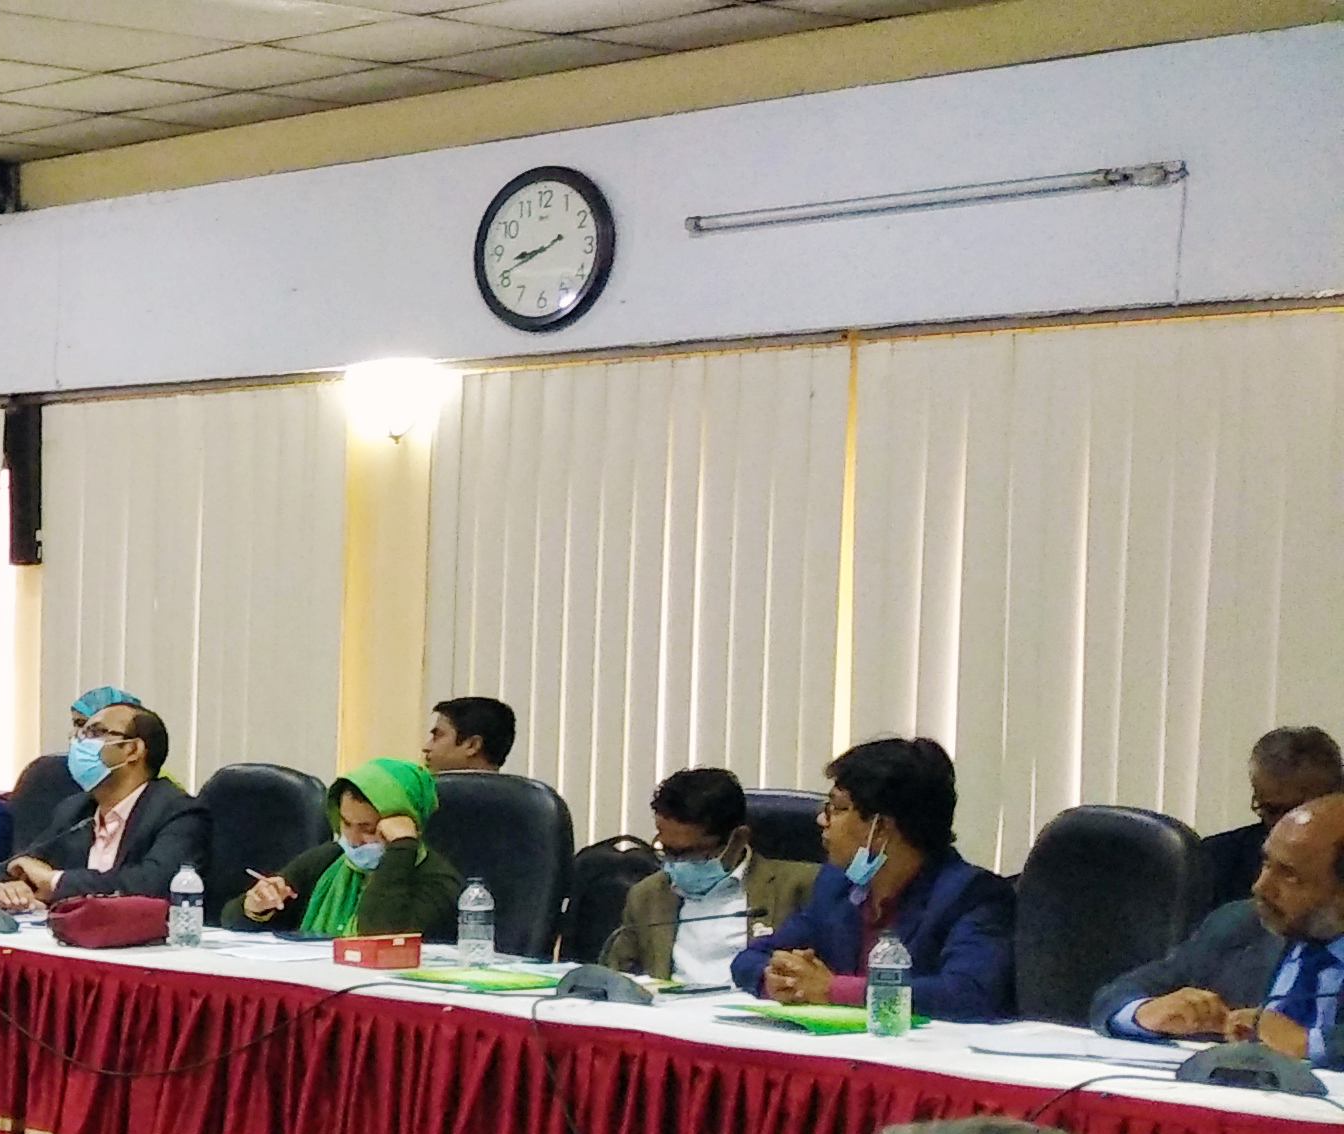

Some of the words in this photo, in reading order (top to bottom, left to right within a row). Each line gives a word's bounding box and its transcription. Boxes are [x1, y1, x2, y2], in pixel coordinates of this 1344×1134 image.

[538, 190, 554, 208] 12
[564, 194, 569, 211] 1
[519, 200, 532, 218] 11
[577, 210, 588, 228] 2
[499, 220, 519, 239] 10
[494, 245, 504, 262] 9
[583, 235, 594, 254] 3
[500, 270, 512, 288] 8
[575, 263, 586, 280] 4
[516, 285, 526, 303] 7
[536, 291, 547, 308] 6
